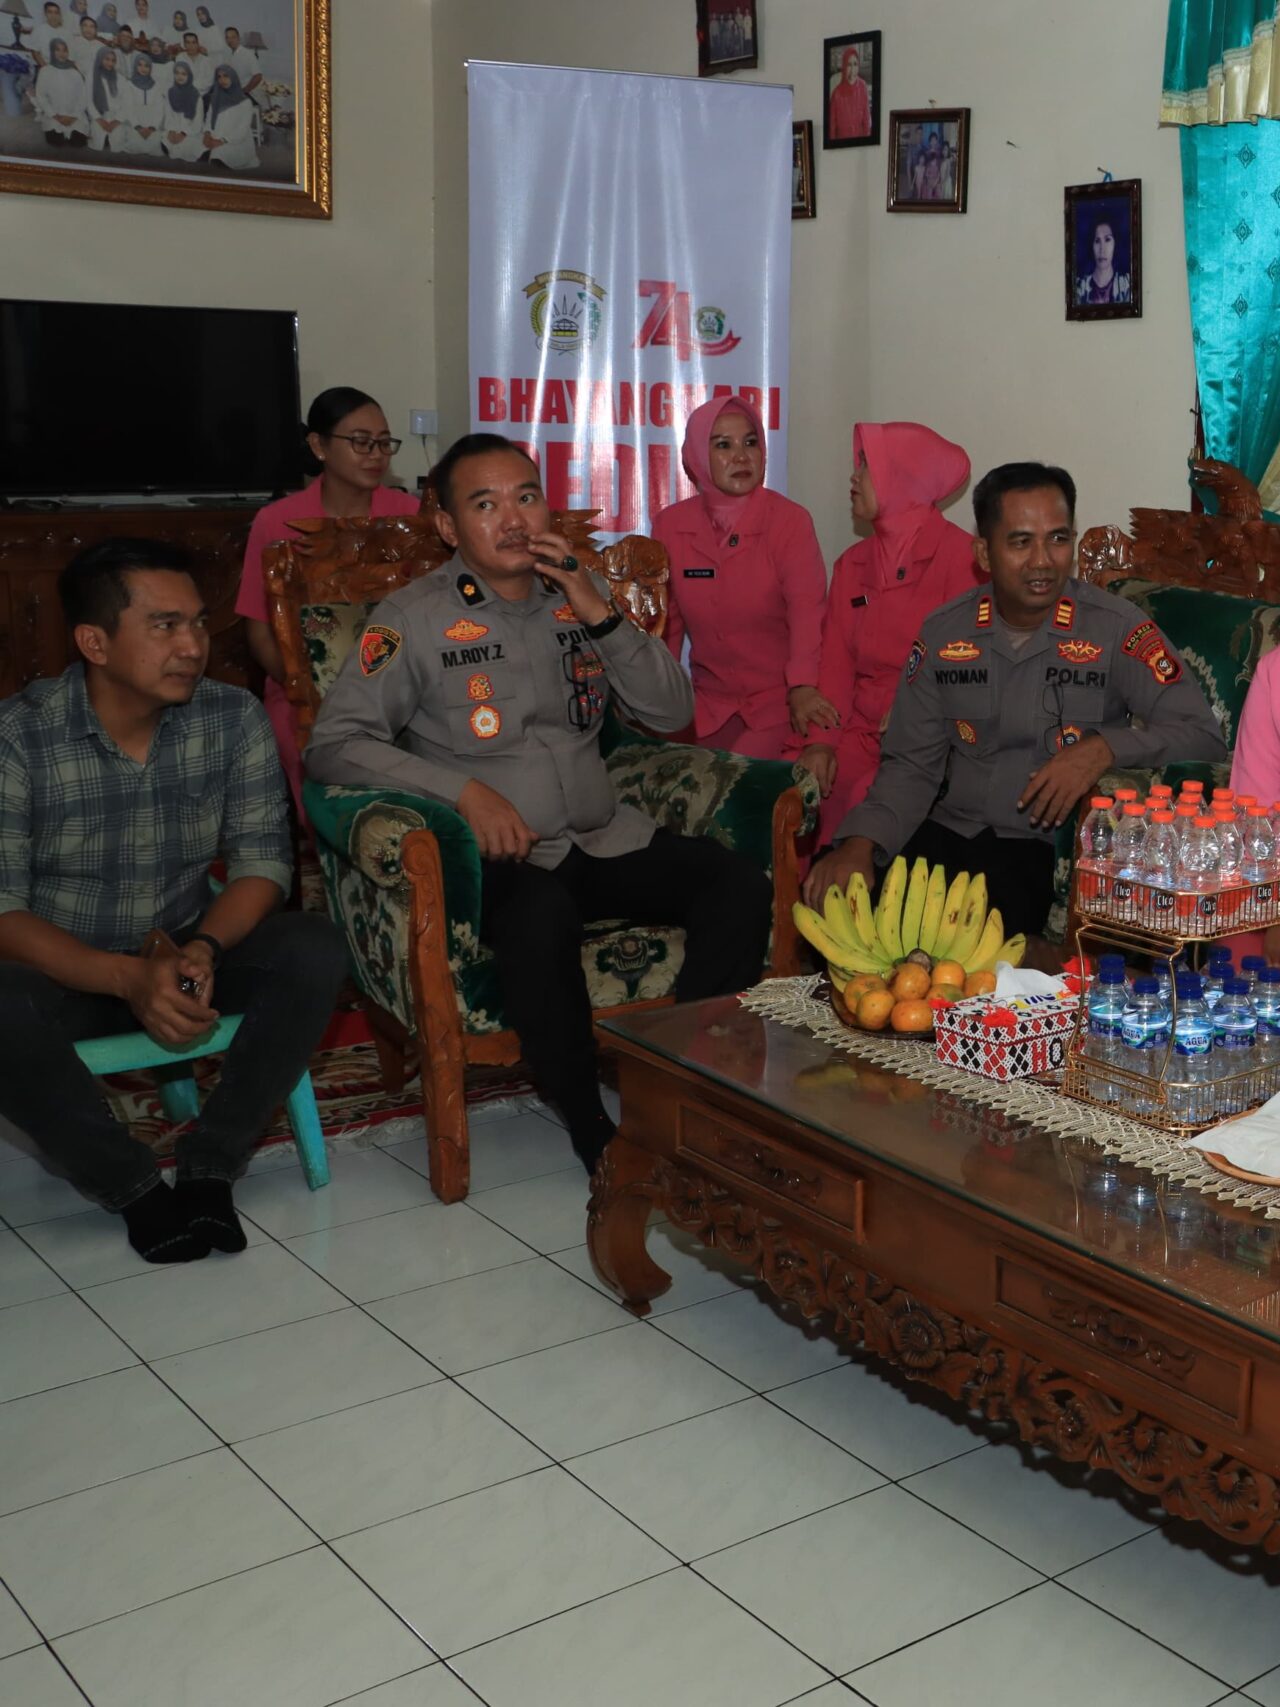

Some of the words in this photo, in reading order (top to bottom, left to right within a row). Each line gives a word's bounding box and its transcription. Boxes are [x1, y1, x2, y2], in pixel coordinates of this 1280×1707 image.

[934, 669, 988, 685] NYOMAN
[1045, 666, 1106, 688] POLRI
[1257, 887, 1273, 897] Cleo
[1184, 1036, 1208, 1047] AQUA
